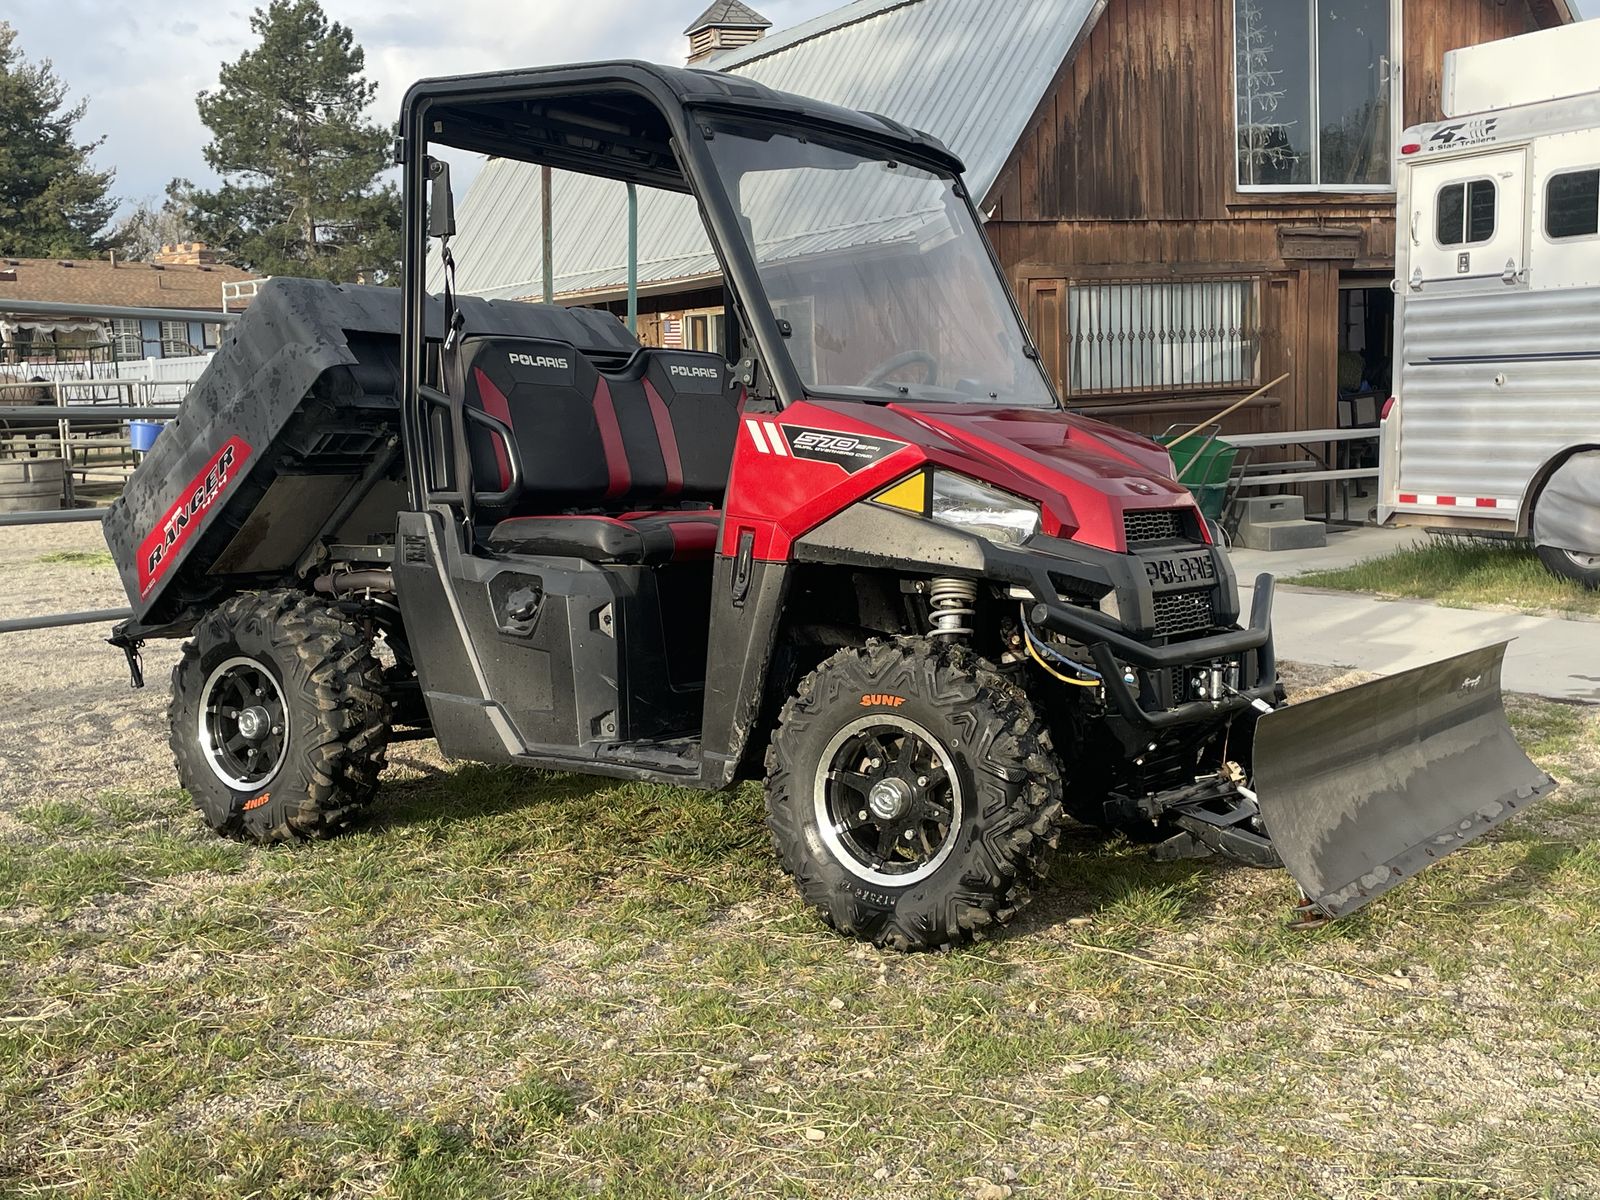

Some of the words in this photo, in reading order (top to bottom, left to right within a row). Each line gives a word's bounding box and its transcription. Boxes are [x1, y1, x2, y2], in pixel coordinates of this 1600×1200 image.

[1428, 142, 1457, 152] 4-Star
[1460, 136, 1497, 147] Trailers
[508, 352, 569, 369] POLARIS
[670, 365, 718, 378] POLARIS
[793, 431, 860, 451] 570
[148, 444, 235, 576] RANGER
[1143, 556, 1214, 586] POLARIS
[859, 693, 906, 707] SUNF
[242, 792, 271, 810] SUNF
